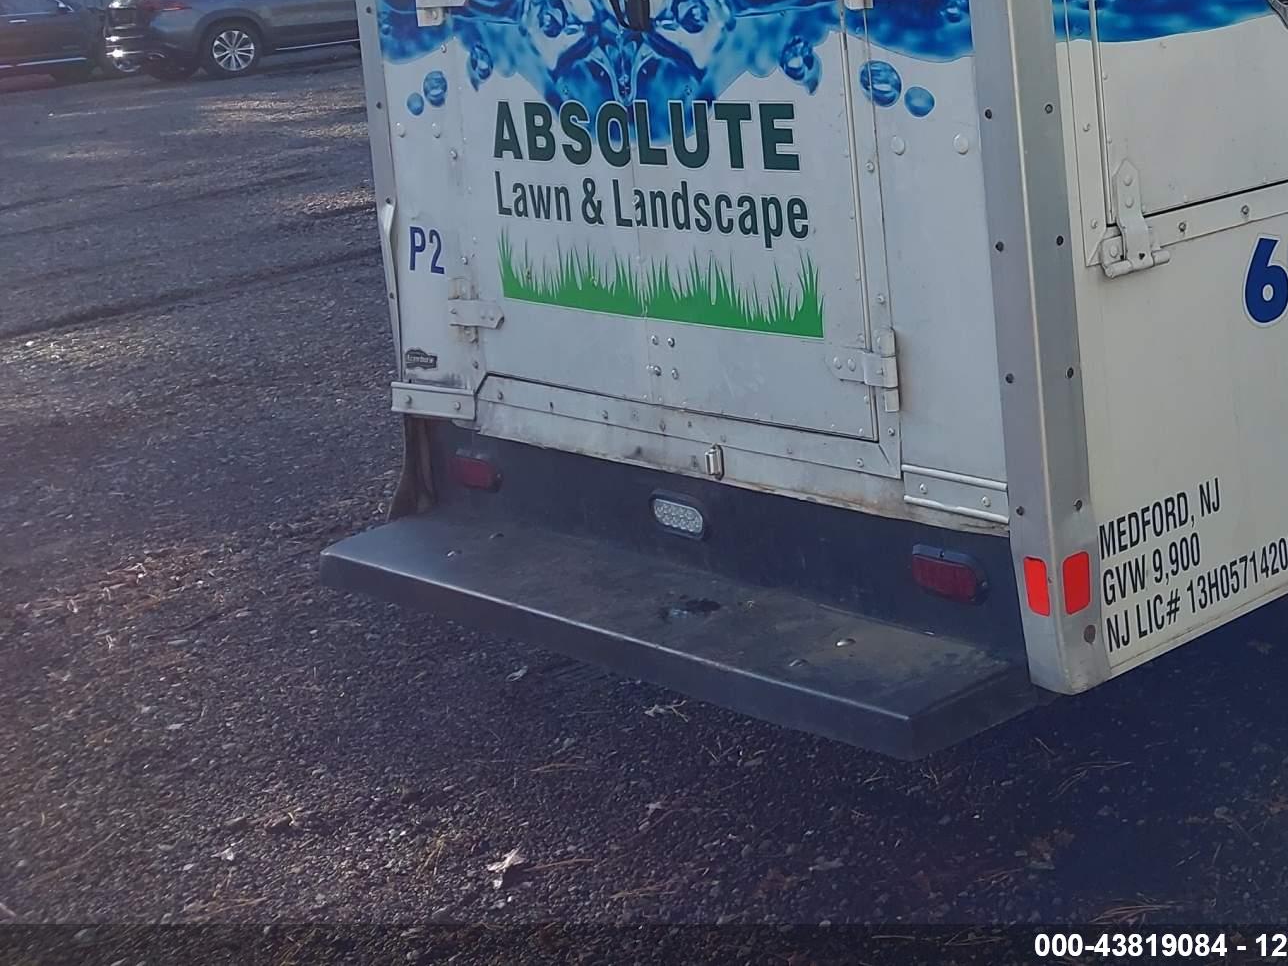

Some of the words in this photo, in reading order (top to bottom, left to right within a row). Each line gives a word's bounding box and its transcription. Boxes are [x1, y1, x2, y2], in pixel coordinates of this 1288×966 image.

[493, 101, 800, 171] ABSOLUTE
[496, 171, 571, 222] Lawn
[582, 178, 603, 224] &
[612, 179, 809, 249] Landscape
[408, 226, 446, 275] P2
[1099, 491, 1196, 560] MEDFORD,
[1199, 477, 1220, 517] NJ
[1103, 554, 1146, 606] GVW
[1152, 532, 1200, 585] 9,900
[1106, 609, 1131, 652] NJ
[1136, 588, 1181, 639] LIC#
